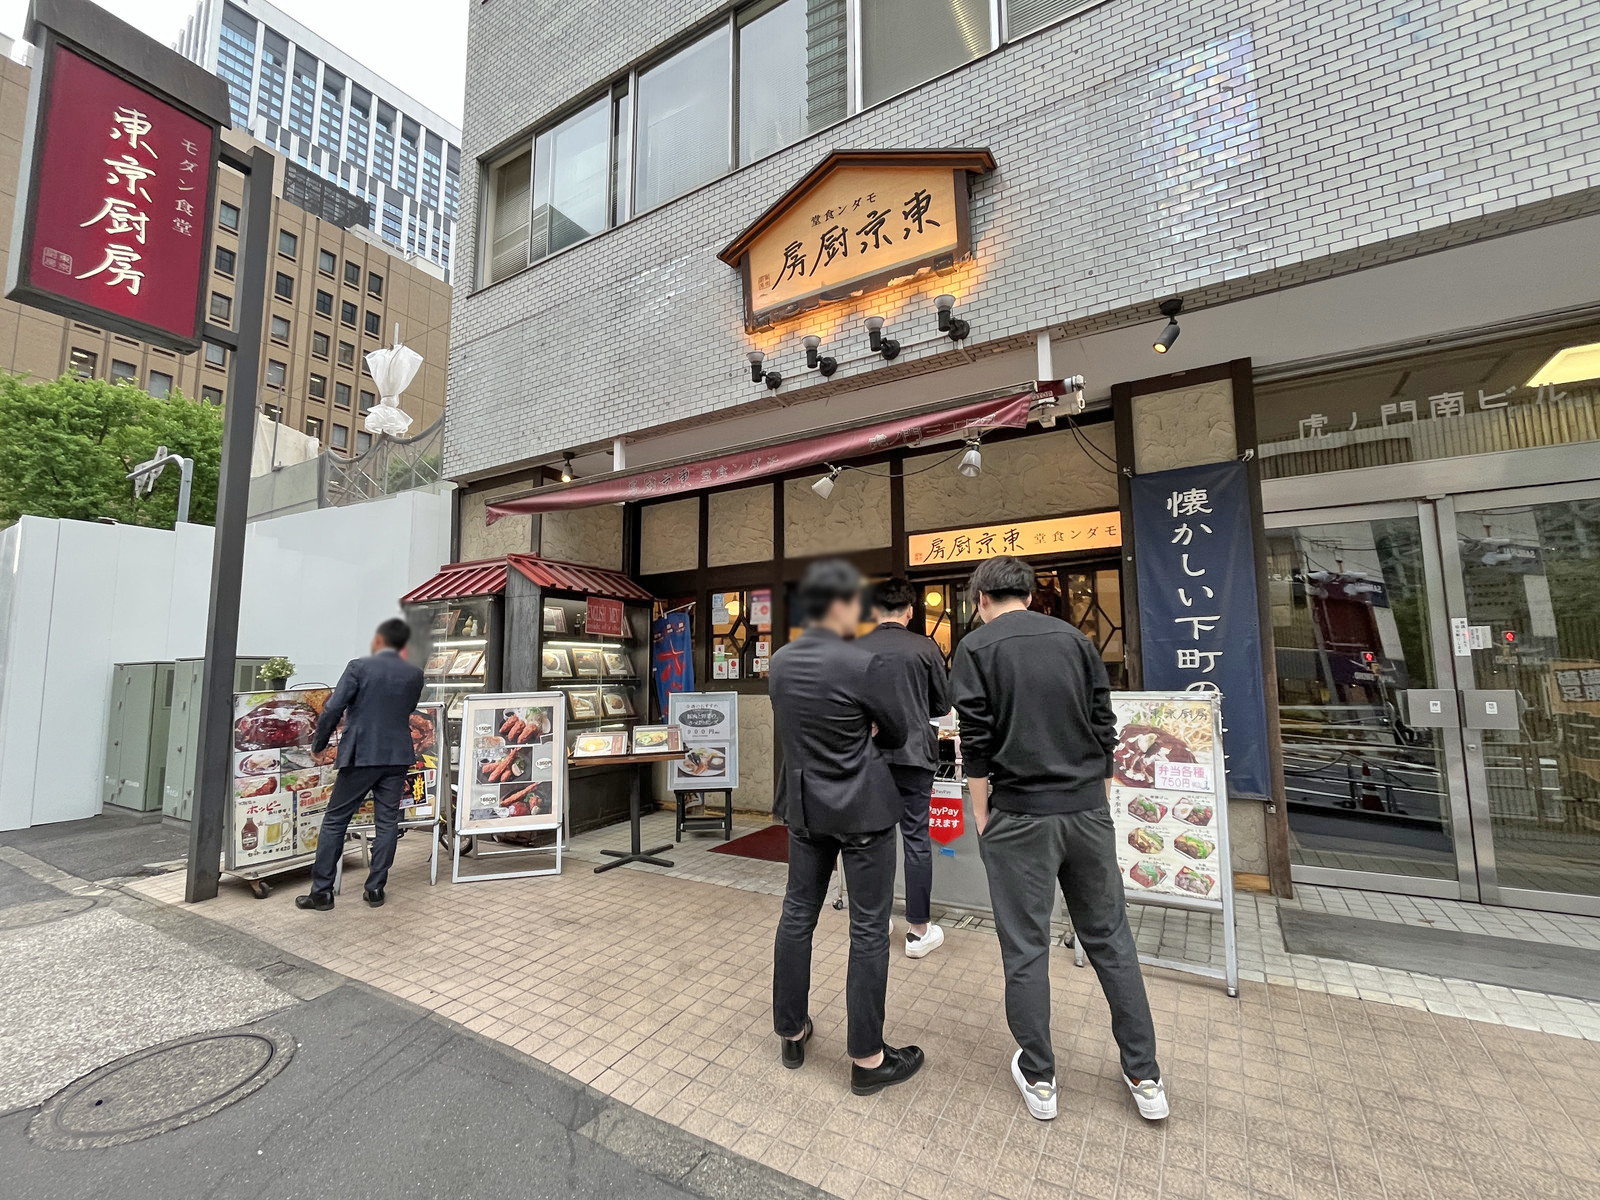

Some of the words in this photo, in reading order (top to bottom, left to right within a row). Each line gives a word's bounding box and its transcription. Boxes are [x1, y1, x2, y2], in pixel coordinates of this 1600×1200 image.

[75, 105, 158, 296] 東京厨房
[172, 138, 199, 237] モダン食堂
[1299, 382, 1567, 440] 虎ノ門南ビル
[1158, 764, 1205, 779] 弁当各種
[1161, 776, 1190, 788] 750円
[246, 800, 281, 814] ホッピー
